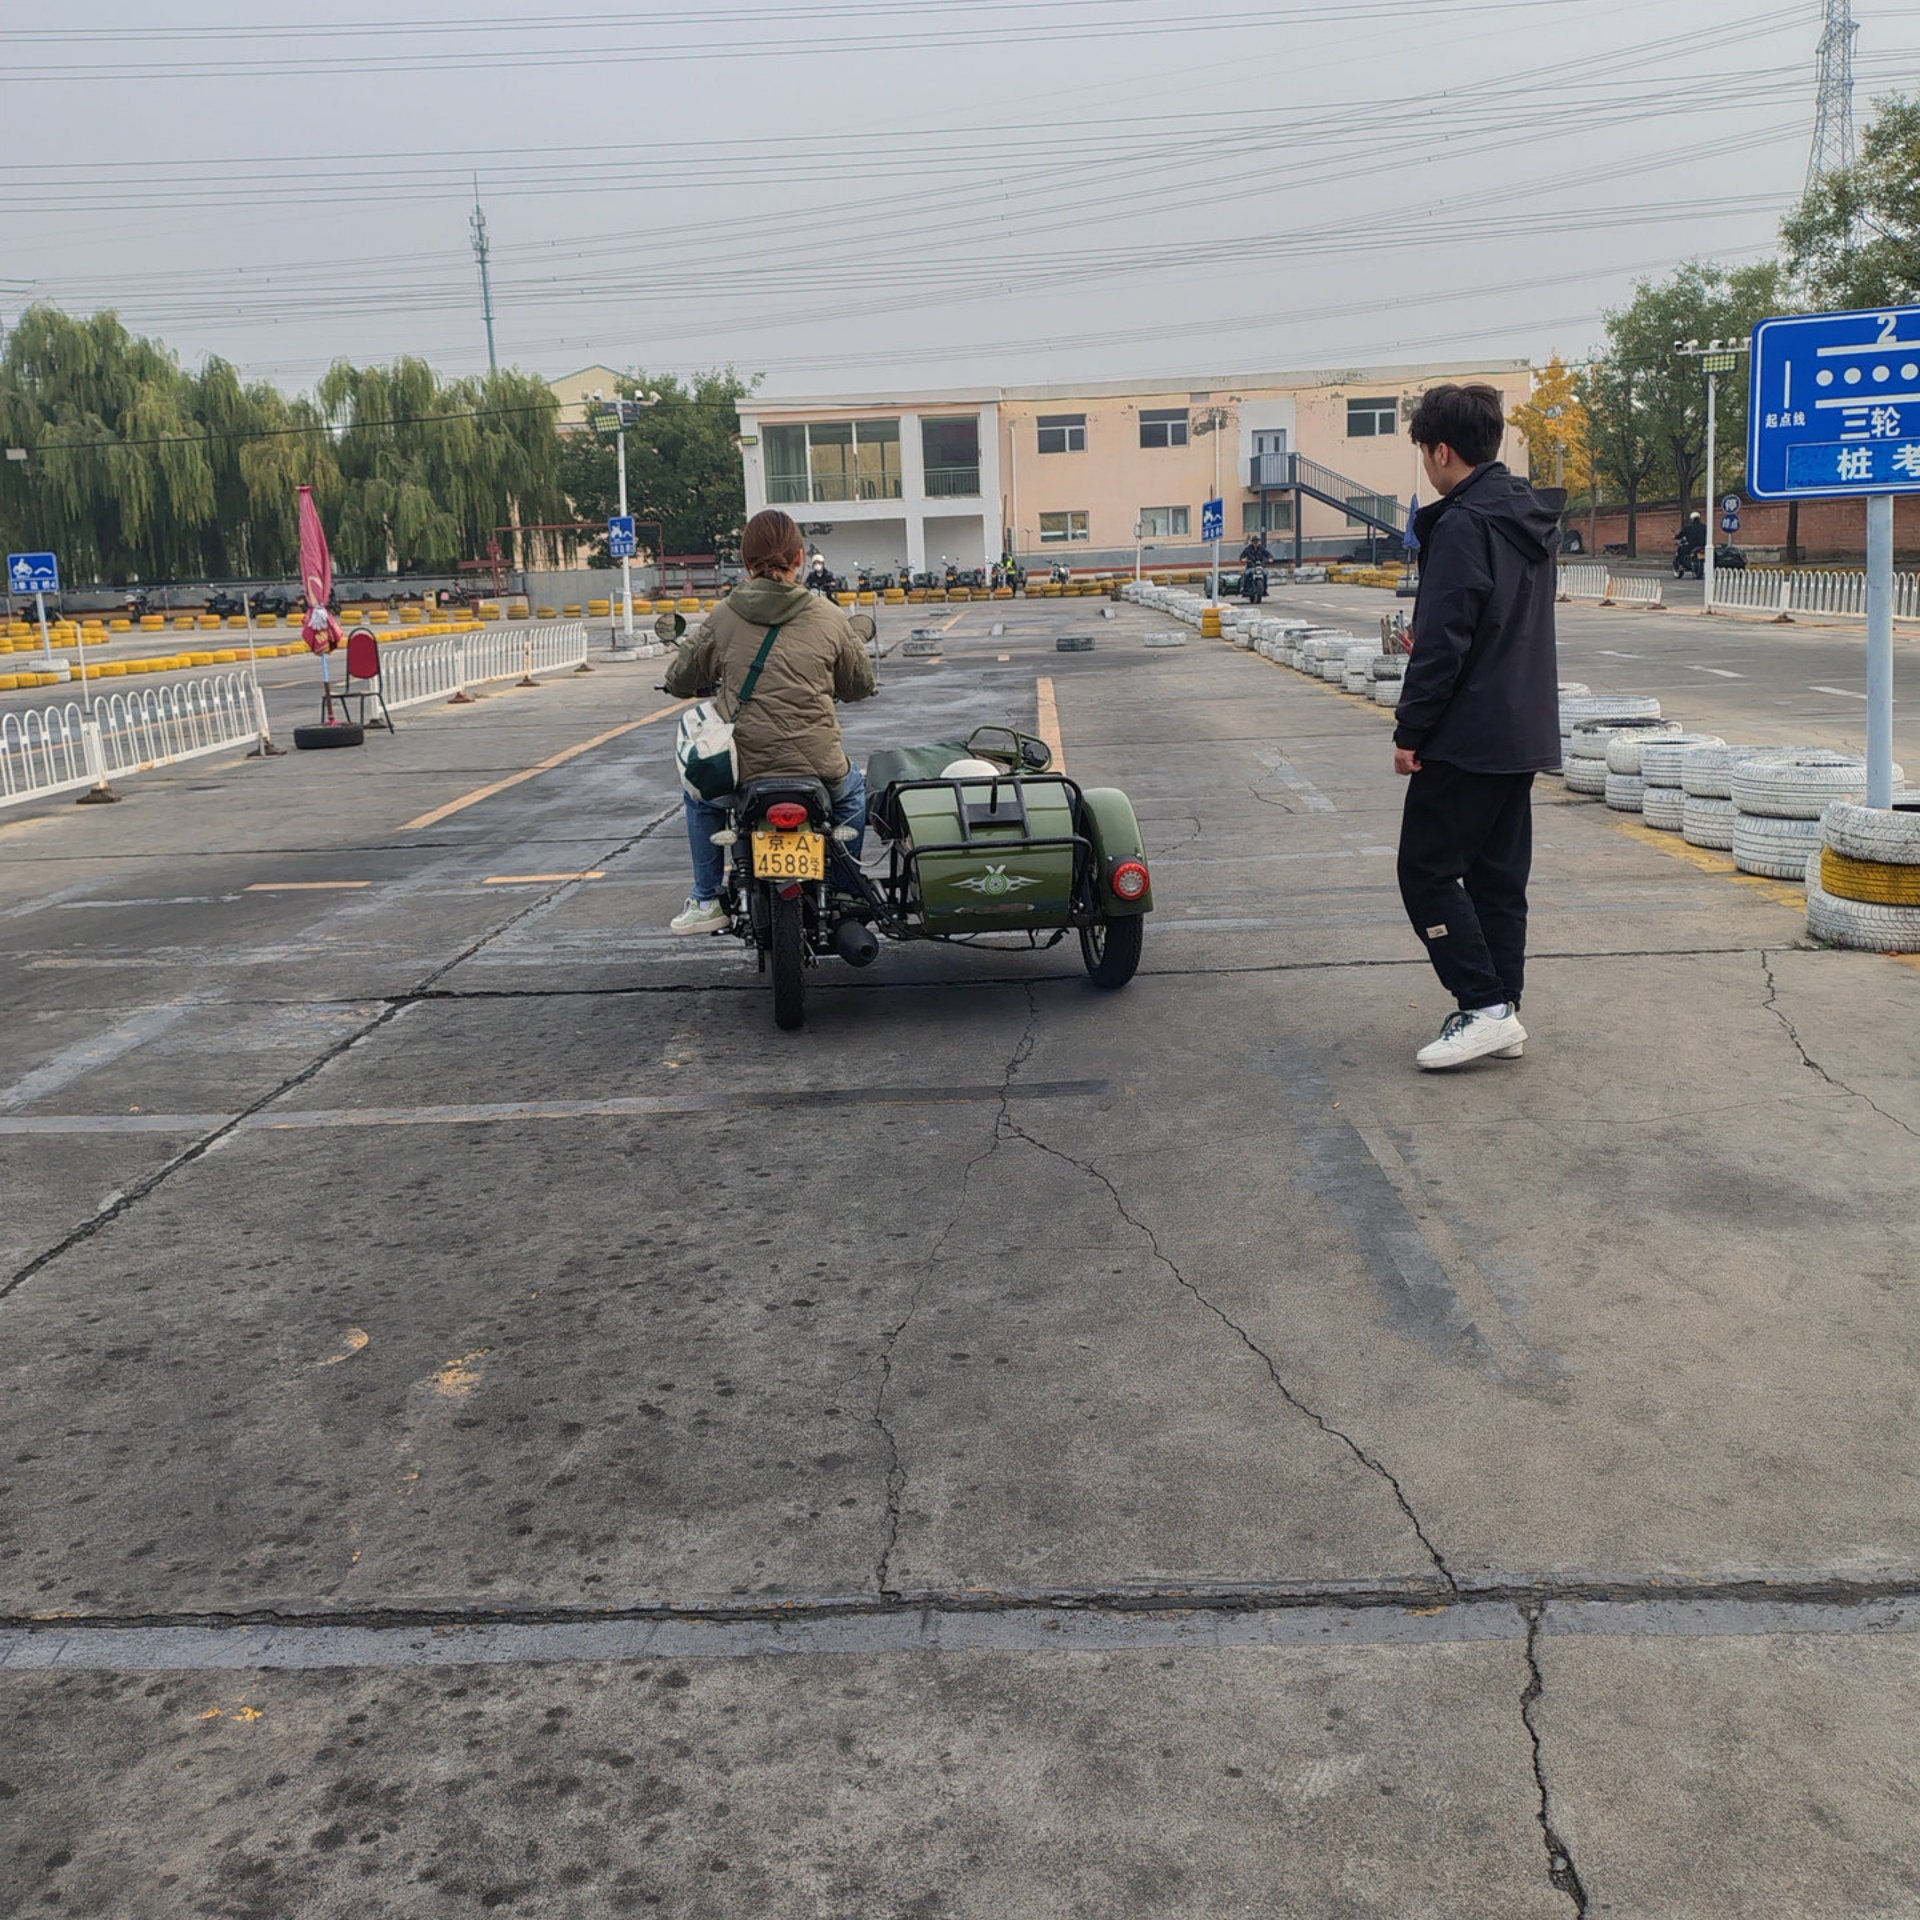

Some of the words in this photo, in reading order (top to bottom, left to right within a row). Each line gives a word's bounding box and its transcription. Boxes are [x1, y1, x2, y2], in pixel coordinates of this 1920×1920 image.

[1877, 314, 1897, 344] 2
[1765, 411, 1806, 428] 起点线
[1840, 406, 1901, 440] 三轮
